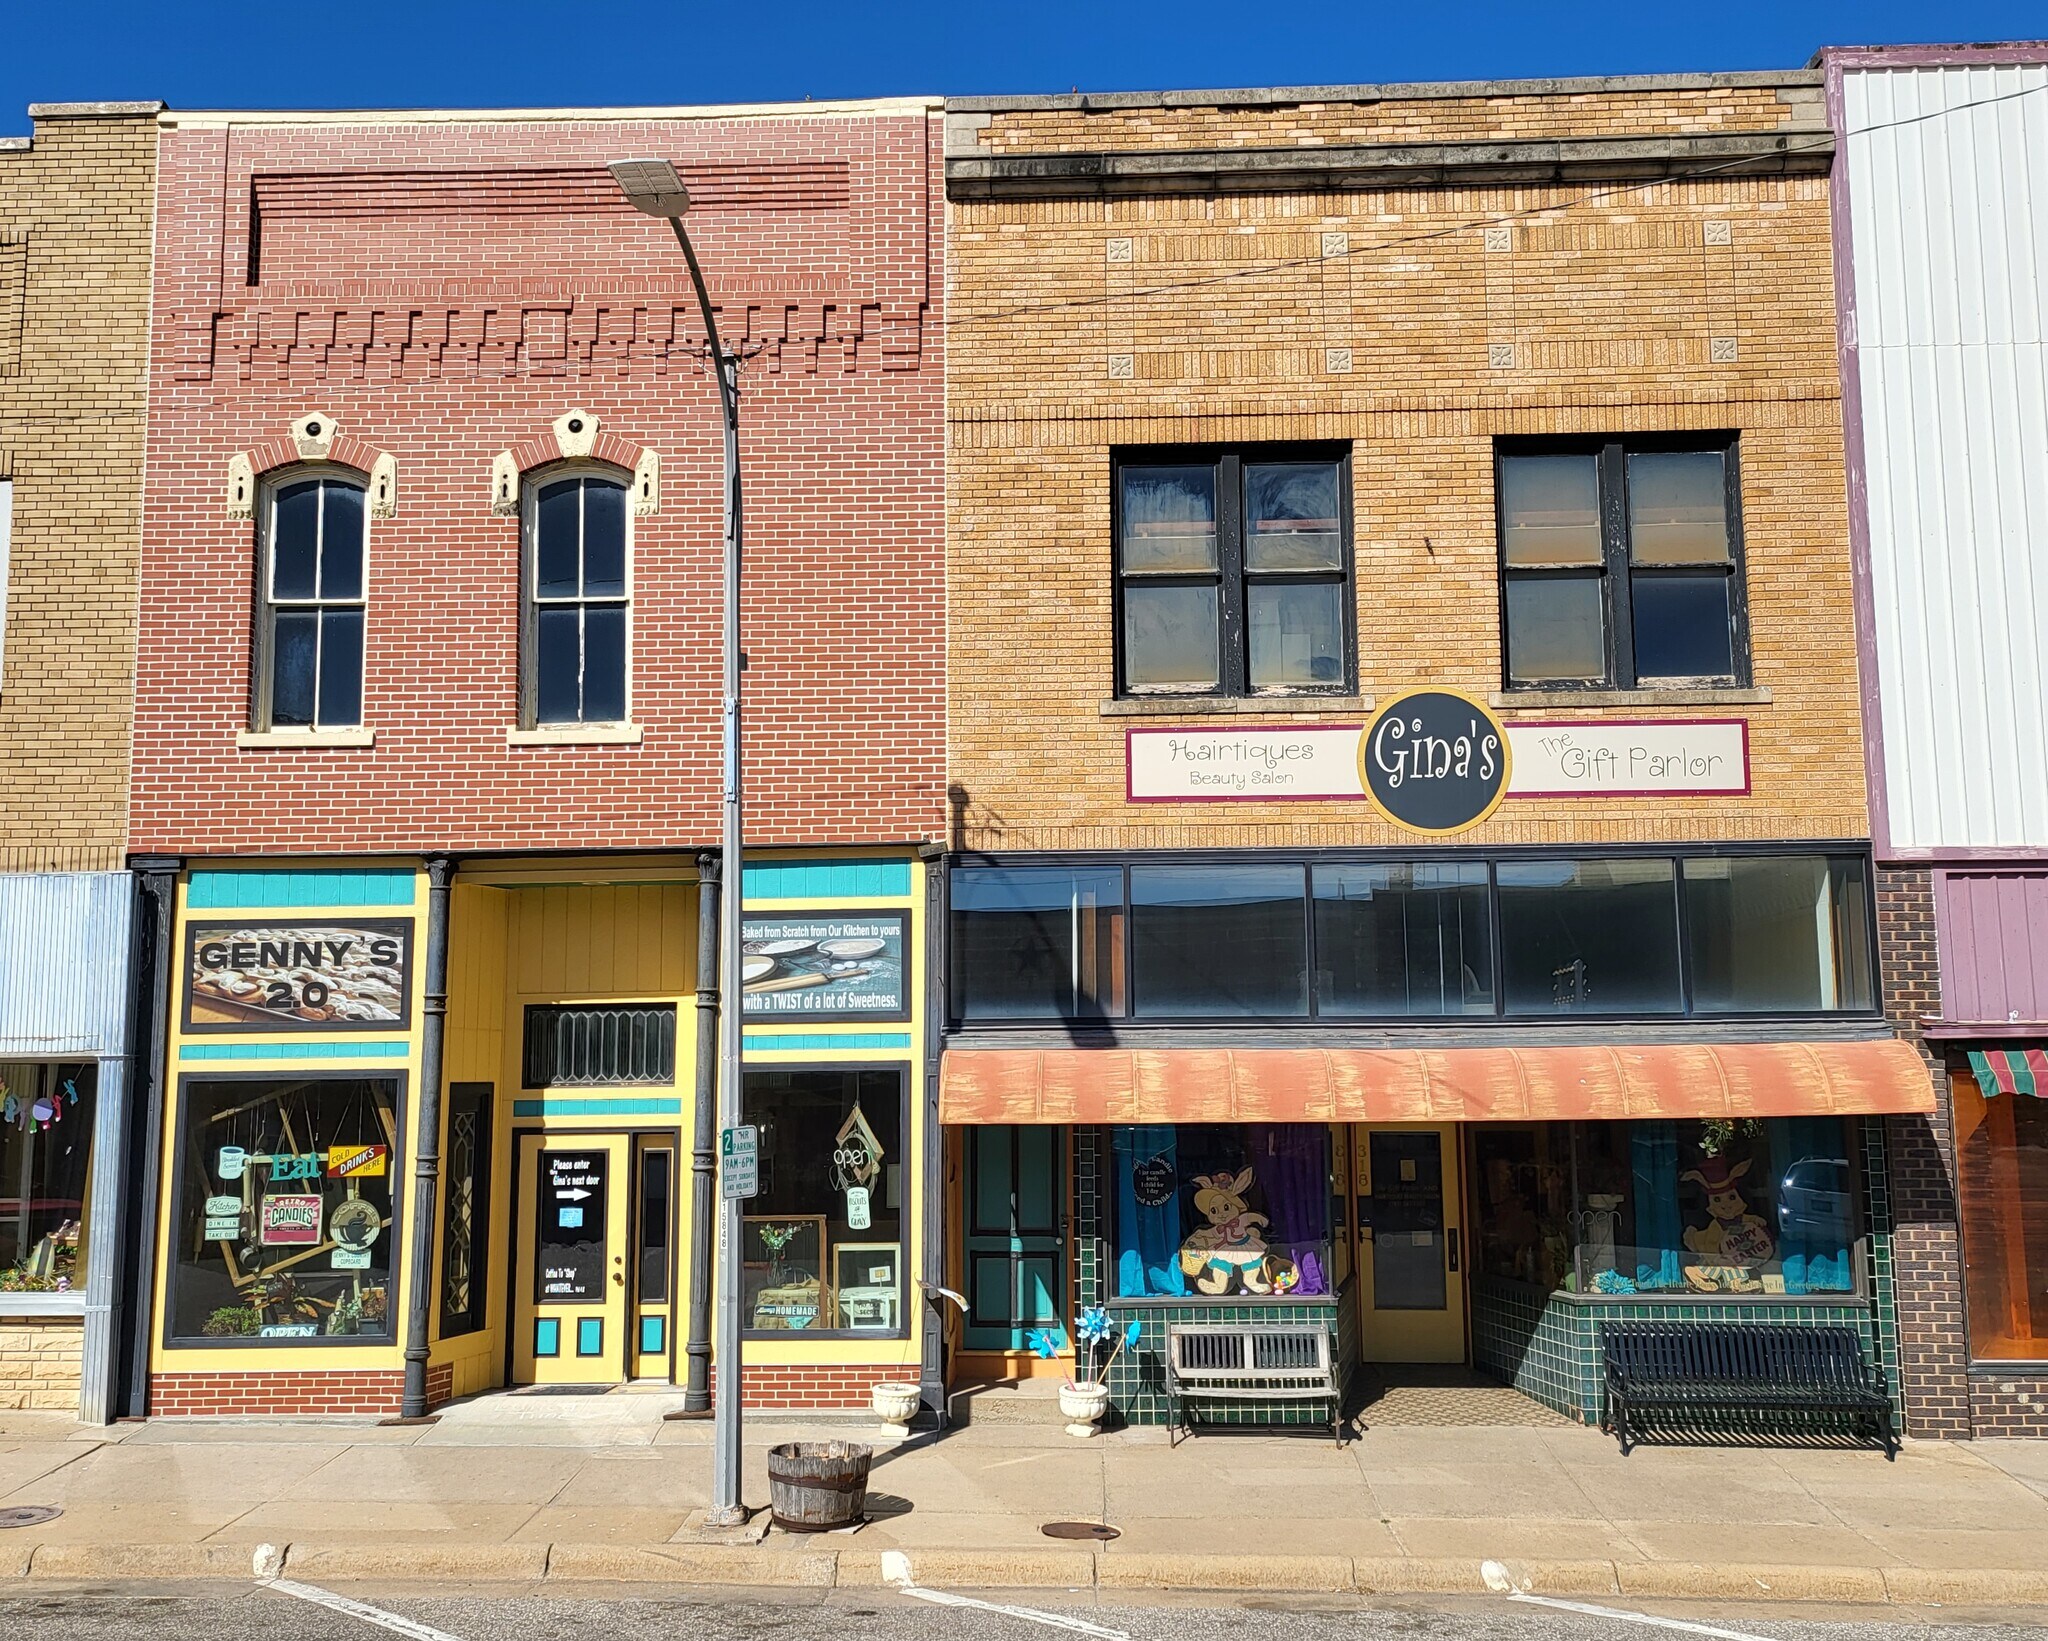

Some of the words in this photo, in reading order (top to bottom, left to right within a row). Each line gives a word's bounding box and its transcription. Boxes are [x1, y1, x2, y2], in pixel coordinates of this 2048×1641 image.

[1168, 738, 1314, 770] Hairtiques
[1374, 716, 1498, 788] Gina's
[1538, 732, 1574, 759] The
[1560, 746, 1619, 781] Gift
[1628, 746, 1725, 779] Parlor
[1190, 771, 1246, 789] Beauty
[1251, 770, 1294, 786] Salon
[742, 925, 763, 938] Baked
[764, 926, 781, 938] from
[782, 925, 809, 937] Scratch
[810, 925, 828, 937] from
[828, 925, 841, 937] Our
[843, 924, 869, 937] Kitchen
[870, 925, 879, 936] to
[880, 926, 900, 938] yours
[200, 936, 398, 969] GENNY'S
[265, 981, 328, 1009] 2.0
[743, 994, 763, 1010] with
[765, 998, 770, 1009] a
[772, 993, 802, 1009] TWIST
[804, 994, 814, 1009] of
[815, 998, 821, 1009] a
[823, 993, 835, 1008] lot
[837, 993, 846, 1008] of
[848, 992, 898, 1008] Sweetness.
[724, 1133, 731, 1152] 2
[740, 1131, 749, 1140] HR
[734, 1141, 755, 1152] PARKING
[331, 1149, 350, 1164] COLD
[340, 1147, 375, 1175] DRINKS
[363, 1157, 381, 1173] HERE
[553, 1159, 573, 1170] Please
[573, 1159, 591, 1170] enter
[725, 1156, 754, 1170] 9AM-6PM
[833, 1149, 871, 1169] open
[270, 1152, 322, 1181] Eat
[553, 1175, 571, 1186] Gina's
[572, 1175, 585, 1185] next
[586, 1175, 600, 1185] door
[724, 1174, 738, 1182] EXCEPT
[738, 1172, 755, 1181] SUNDAYS
[736, 1182, 753, 1190] HOLIDAYS
[208, 1200, 240, 1213] Kitchen
[279, 1198, 306, 1207] RETRO
[271, 1207, 314, 1226] CANDIES
[332, 1202, 379, 1225] COFFEE
[1725, 1227, 1757, 1250] HAPPY
[1732, 1240, 1769, 1264] EASTER
[776, 1306, 817, 1316] HOMEMADE
